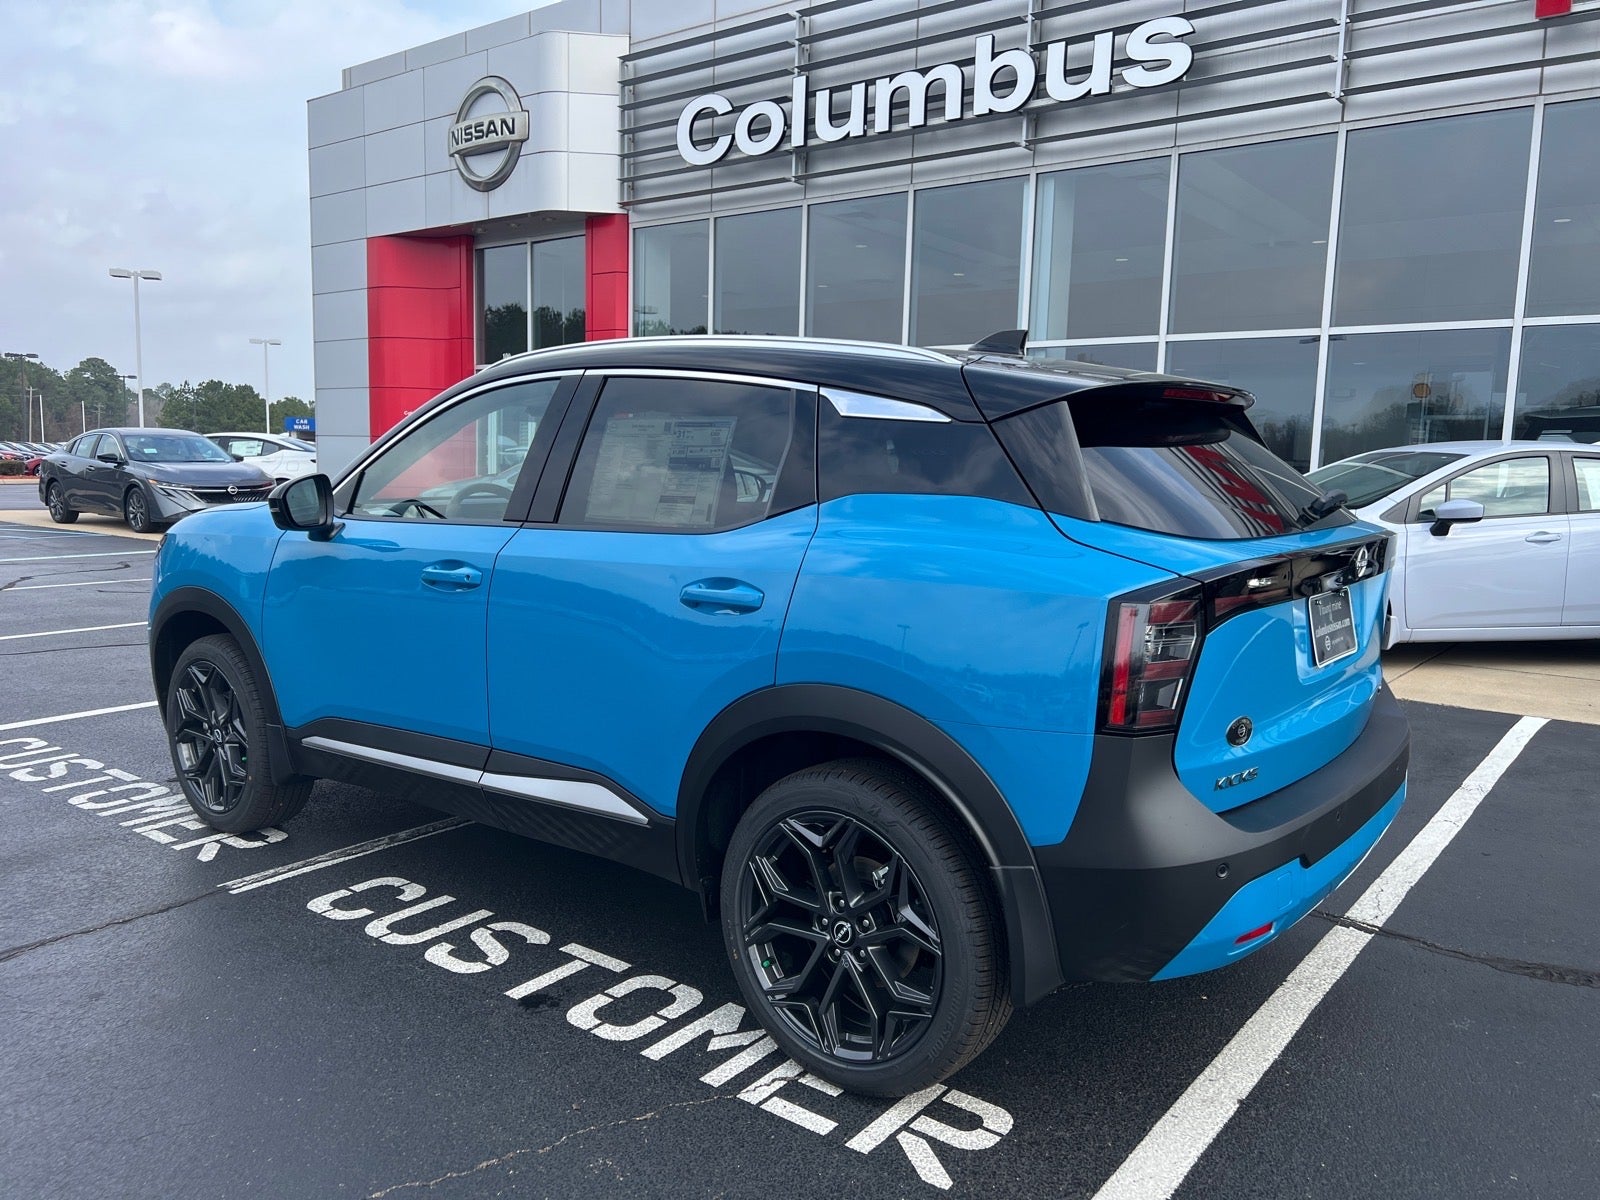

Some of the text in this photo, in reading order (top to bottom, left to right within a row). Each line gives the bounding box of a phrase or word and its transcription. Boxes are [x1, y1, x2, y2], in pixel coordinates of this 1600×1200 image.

[451, 117, 516, 147] NISSAN
[676, 16, 1196, 166] Columbus
[1214, 766, 1259, 792] KICKS
[307, 876, 1014, 1190] CUSTOMER
